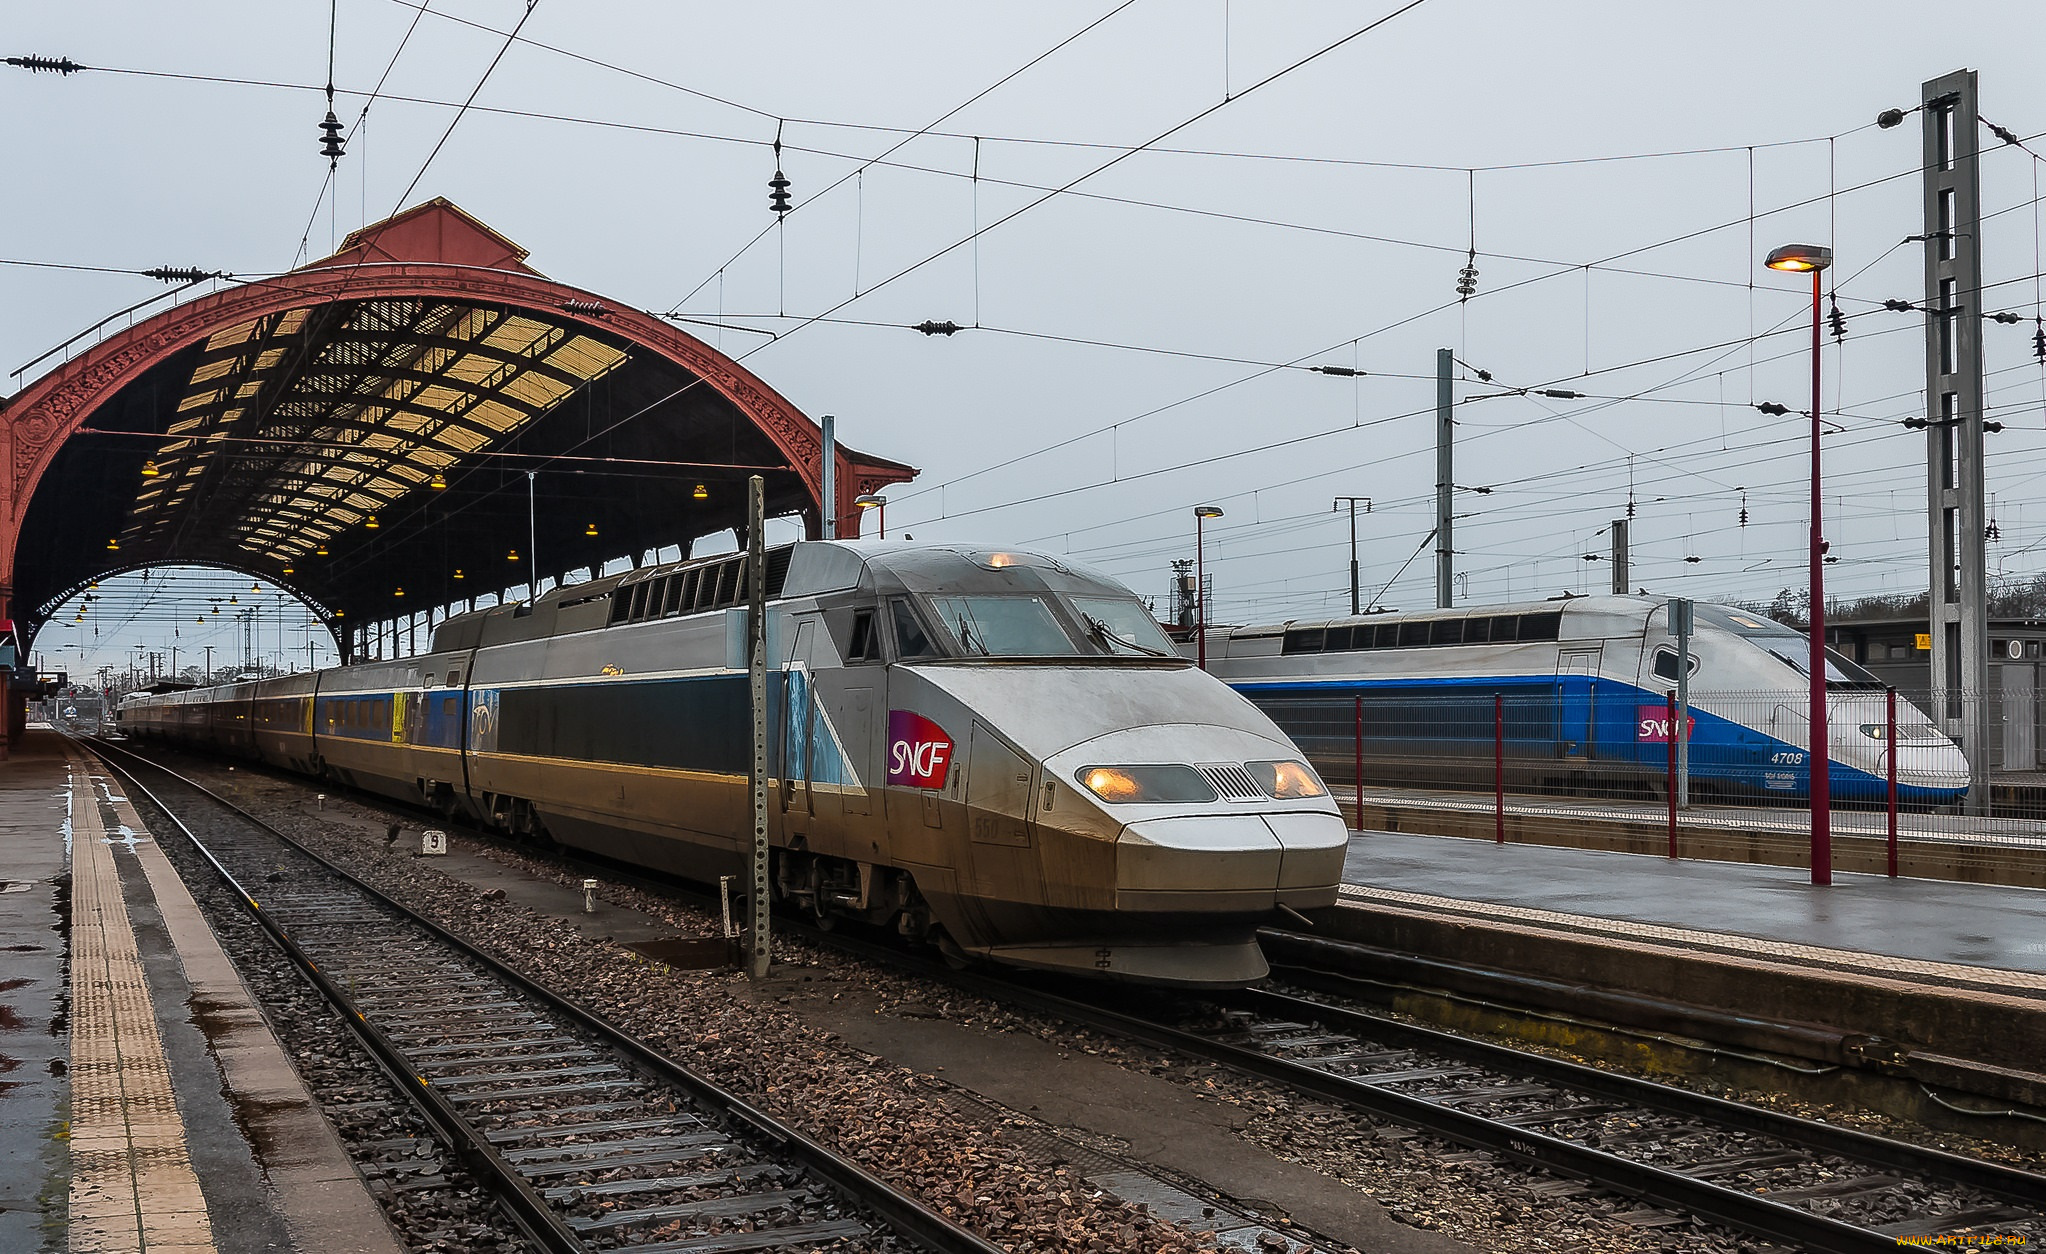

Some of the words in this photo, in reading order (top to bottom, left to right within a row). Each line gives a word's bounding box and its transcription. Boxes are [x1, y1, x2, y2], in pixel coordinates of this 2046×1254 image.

[889, 740, 949, 777] SNCF
[1771, 752, 1803, 764] 4708
[430, 835, 439, 849] 9
